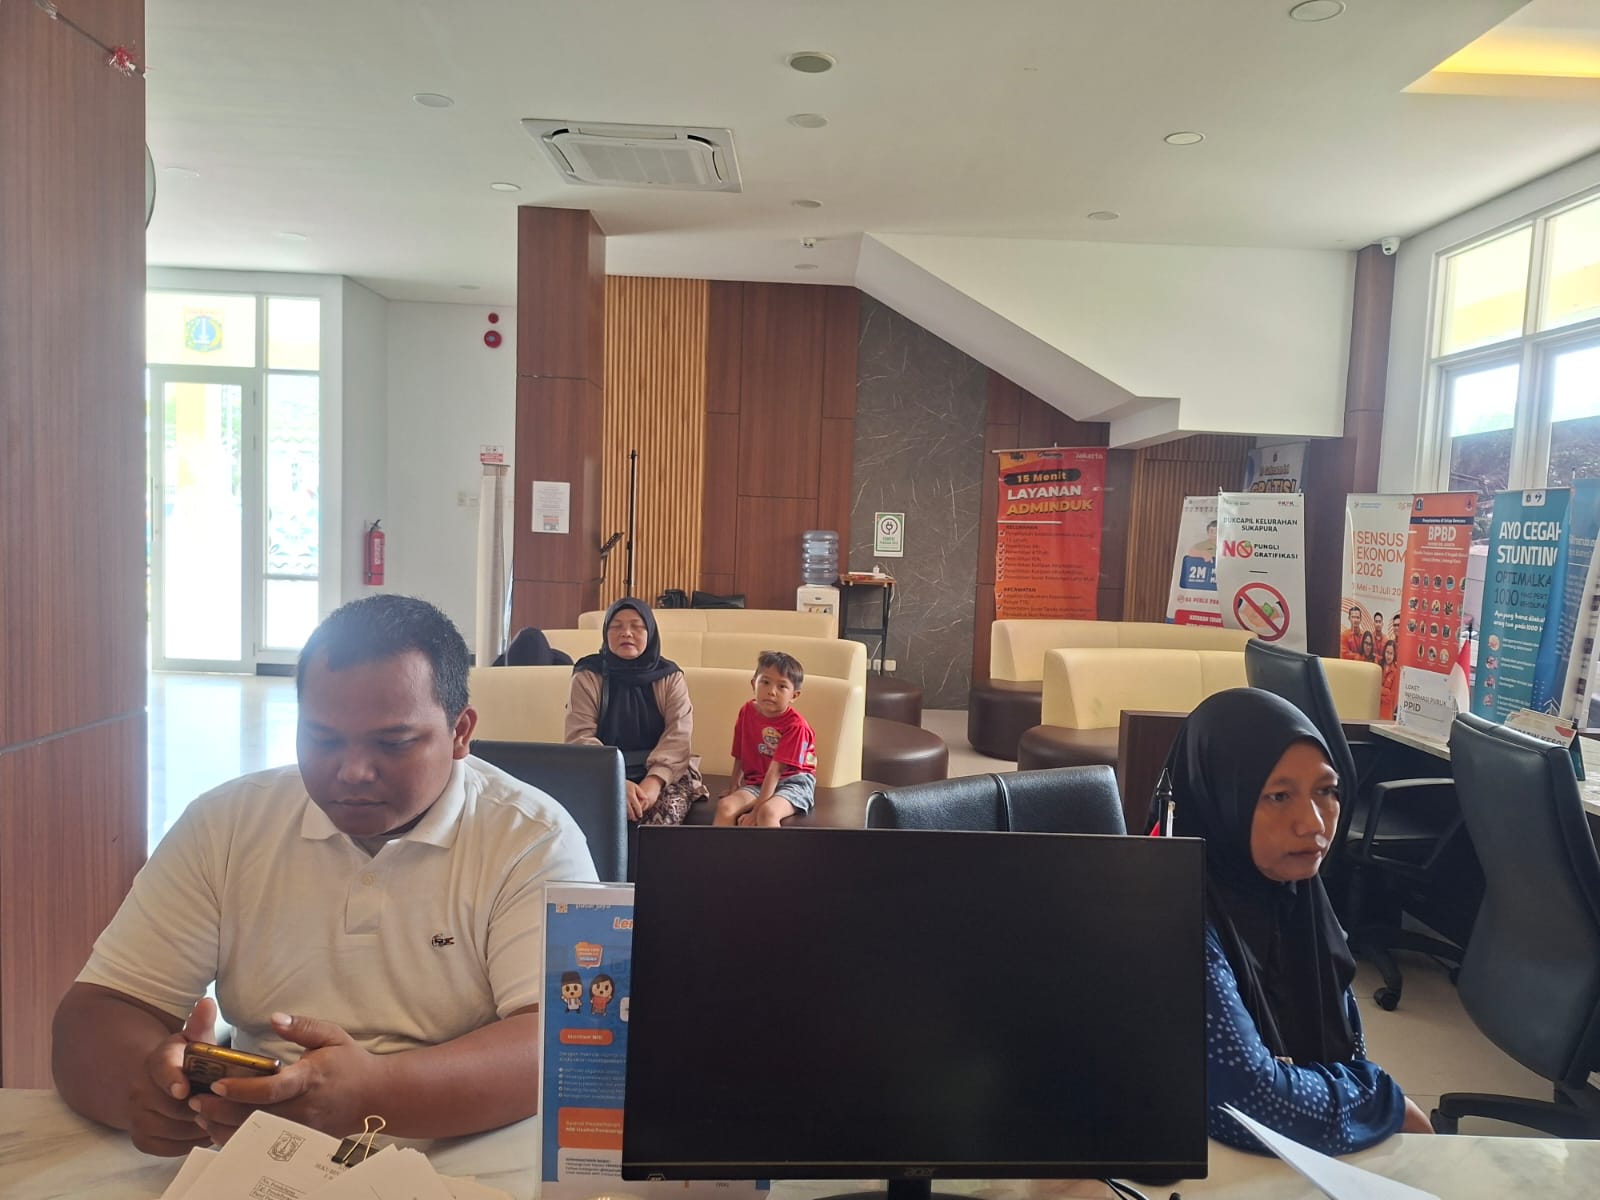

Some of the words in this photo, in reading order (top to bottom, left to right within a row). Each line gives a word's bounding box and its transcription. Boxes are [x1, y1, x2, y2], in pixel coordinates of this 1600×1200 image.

[1017, 475, 1030, 483] 15
[1033, 471, 1067, 482] Menit
[1007, 485, 1082, 500] LAYANAN
[1007, 499, 1093, 516] ADMINDUK
[1356, 530, 1404, 546] SENSUS
[1428, 525, 1457, 541] BPBD
[1498, 521, 1522, 540] AYO
[1357, 546, 1407, 563] EKONOM
[1189, 566, 1207, 579] 2M
[1356, 562, 1383, 577] 2026
[1495, 570, 1552, 588] OPTIMALKA
[1356, 583, 1368, 592] Mei
[1379, 585, 1391, 595] Juli
[1392, 587, 1402, 596] 20
[1403, 700, 1421, 712] PPID
